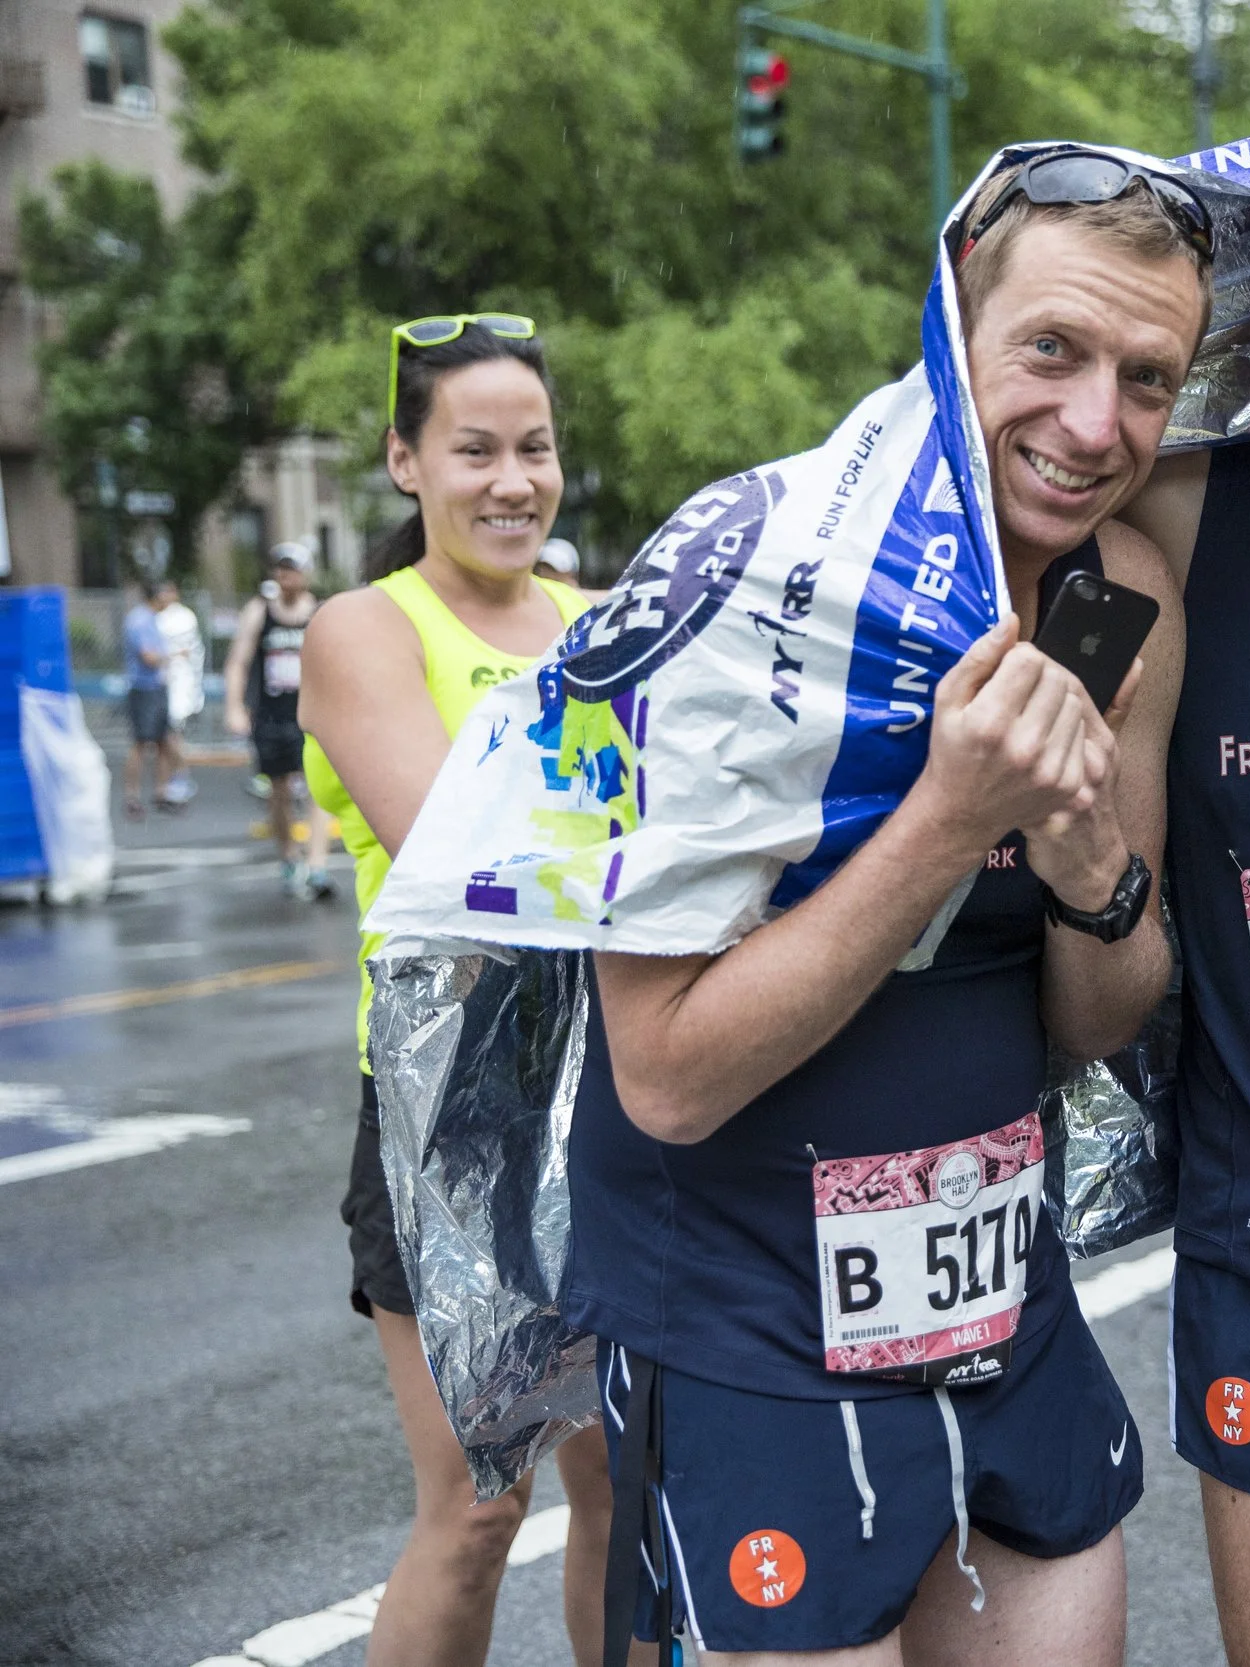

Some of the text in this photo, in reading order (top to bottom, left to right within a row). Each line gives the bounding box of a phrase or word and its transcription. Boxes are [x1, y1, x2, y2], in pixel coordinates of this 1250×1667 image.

[816, 420, 884, 540] RUN FOR LIFE
[766, 557, 827, 725] NYRR
[887, 533, 960, 733] UNITED
[988, 846, 1017, 869] RK
[940, 1170, 979, 1189] BROOKLYN
[952, 1182, 970, 1197] HALF
[834, 1246, 883, 1315] B
[951, 1322, 990, 1347] WAVE 1
[945, 1358, 1002, 1380] NYRR
[1223, 1383, 1244, 1399] FR
[1223, 1424, 1242, 1441] NY
[749, 1535, 775, 1556] FR
[761, 1581, 786, 1602] NY
